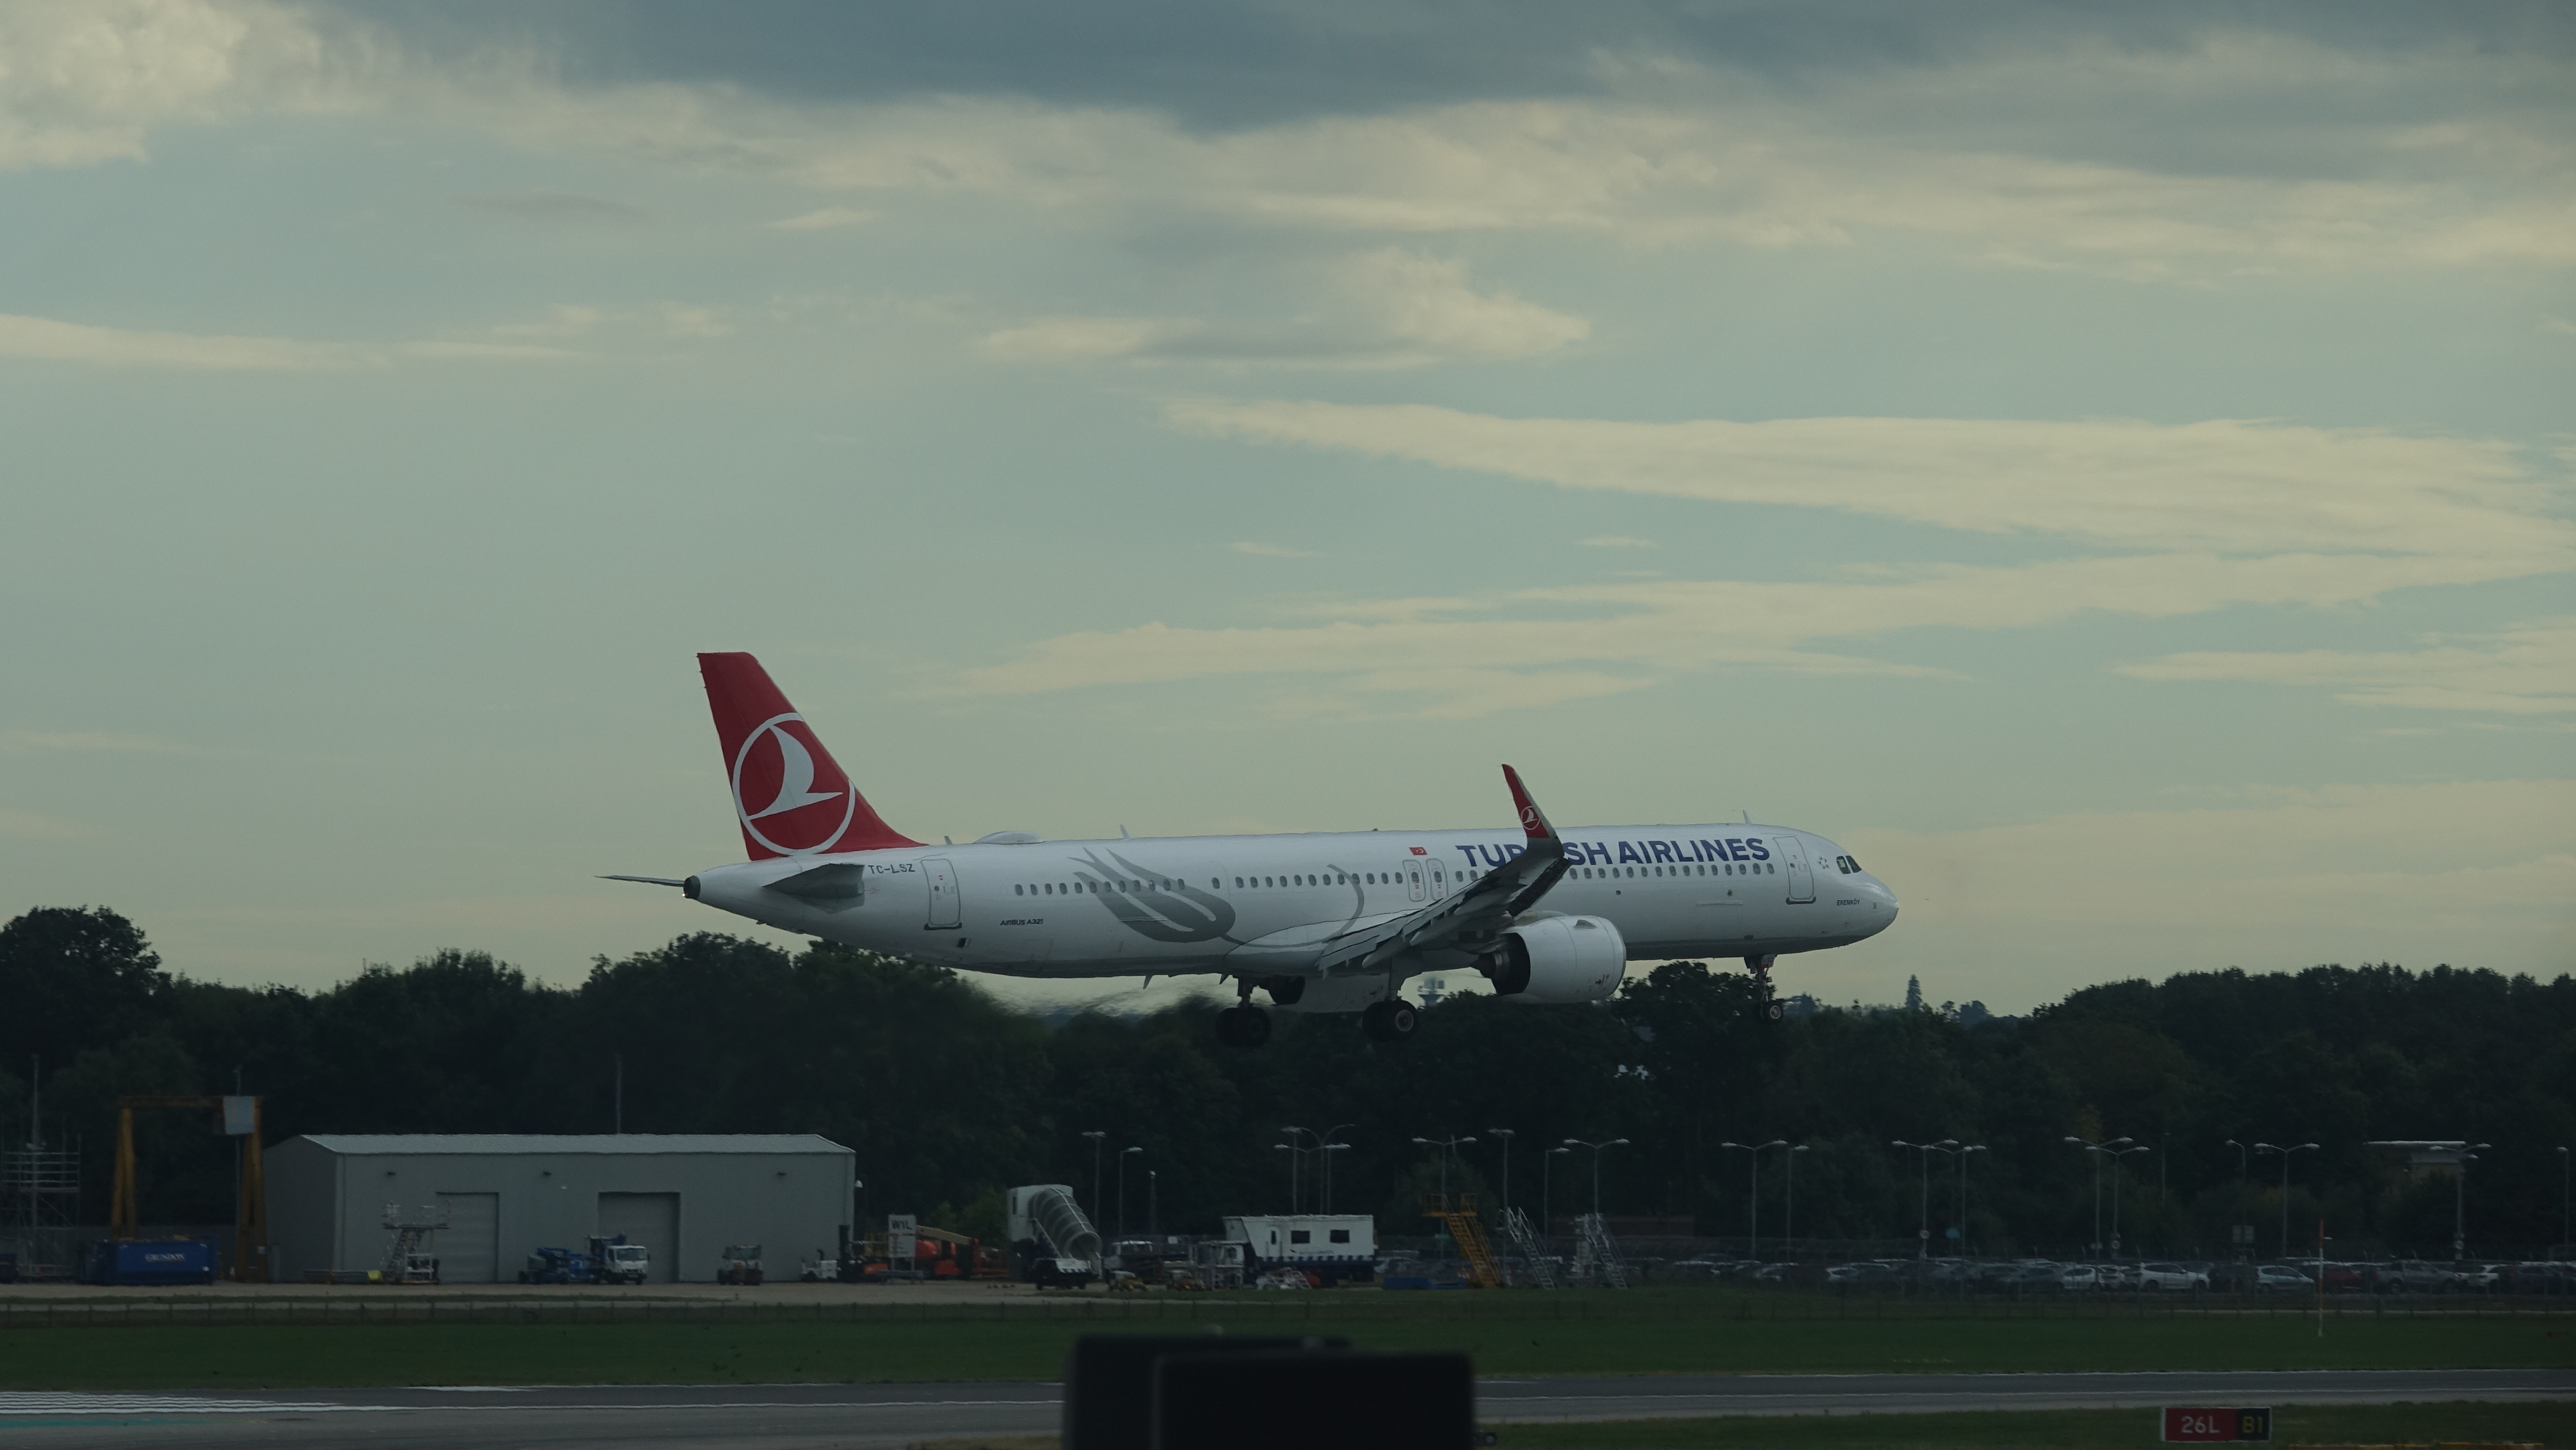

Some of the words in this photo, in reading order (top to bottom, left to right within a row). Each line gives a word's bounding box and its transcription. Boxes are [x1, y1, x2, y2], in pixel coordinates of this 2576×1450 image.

[1618, 838, 1770, 864] AIRLINES
[868, 863, 915, 874] TC-LSZ
[2181, 1415, 2221, 1434] 26L
[2242, 1416, 2263, 1434] B1
